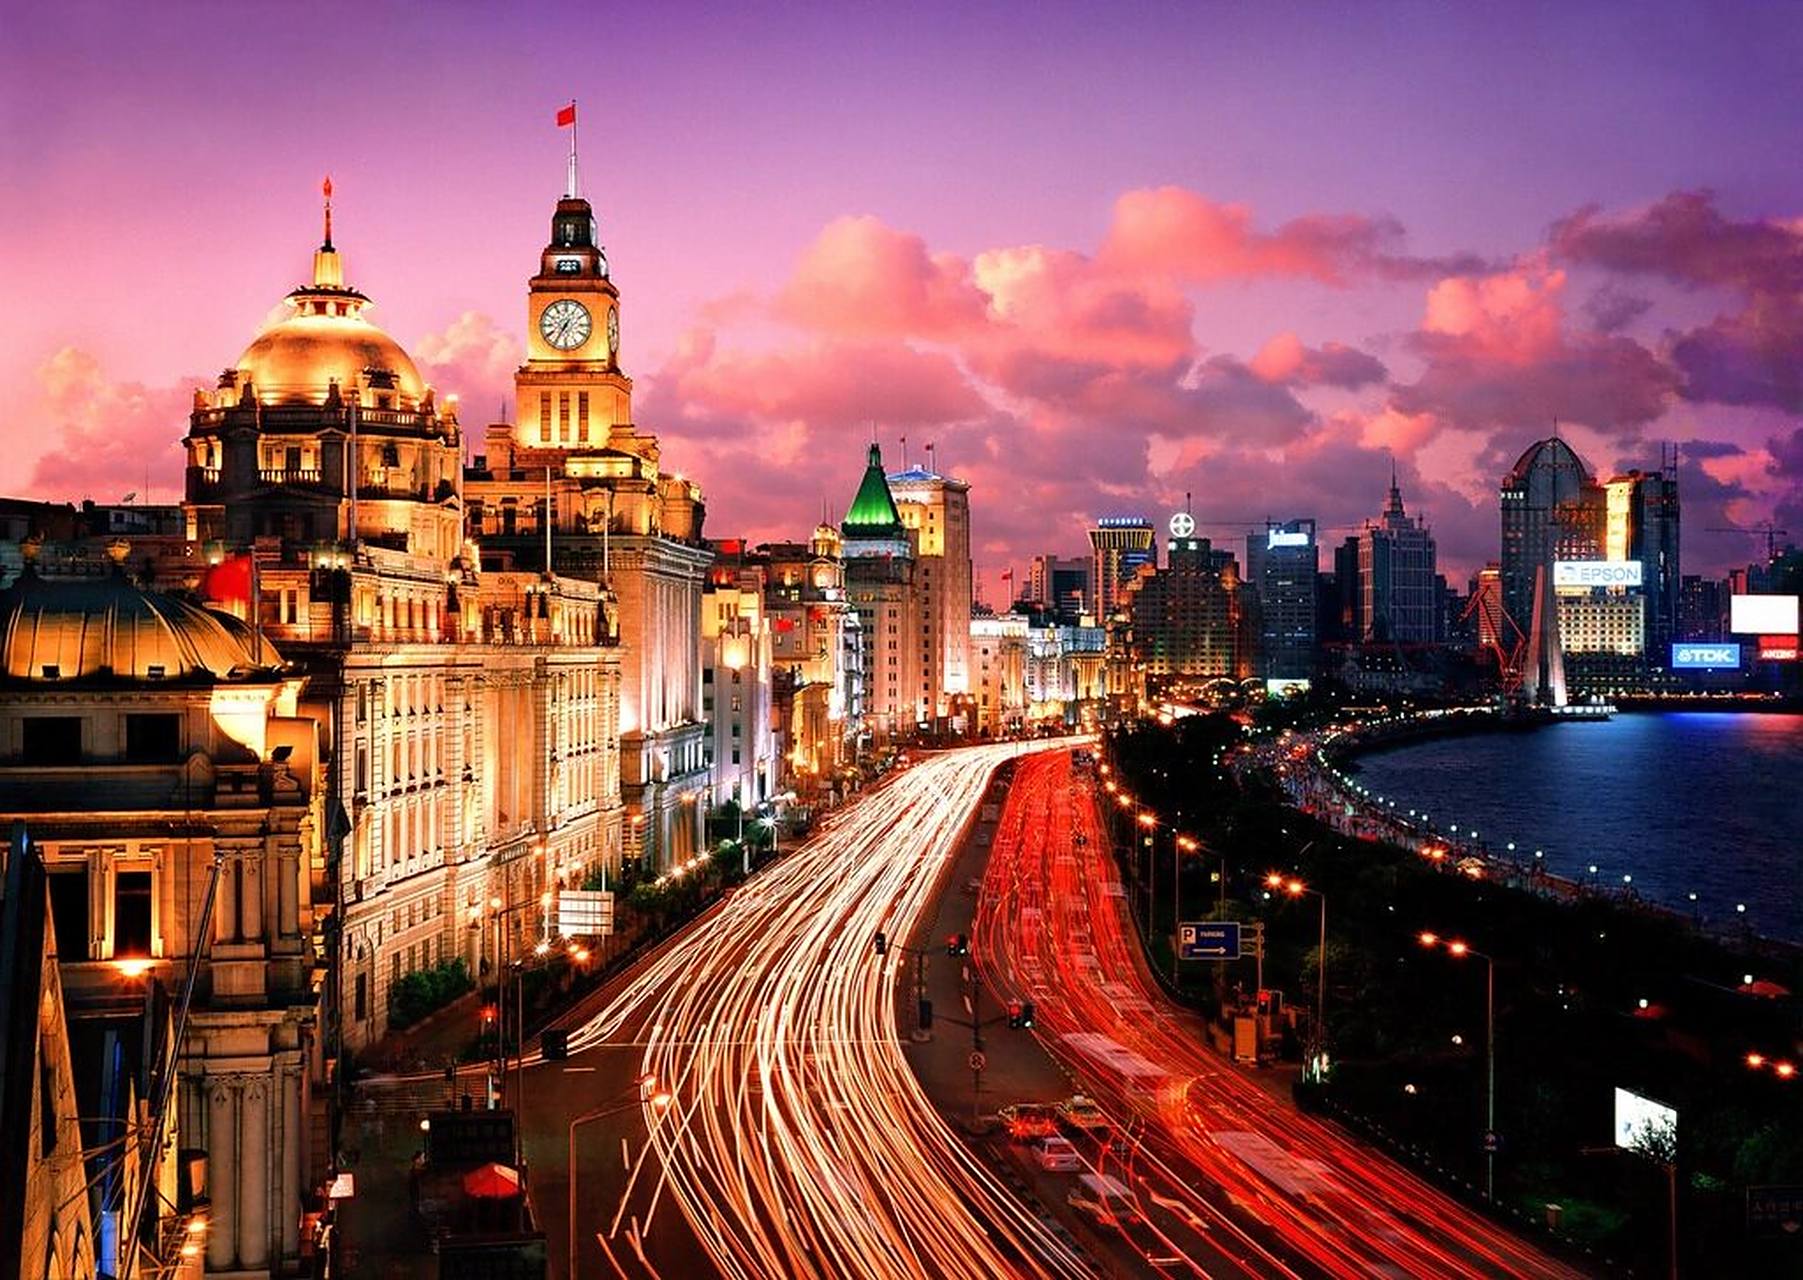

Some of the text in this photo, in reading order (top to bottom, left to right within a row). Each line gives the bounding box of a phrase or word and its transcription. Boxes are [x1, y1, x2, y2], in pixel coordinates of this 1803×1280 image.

[1581, 567, 1638, 582] EPSON
[1690, 649, 1735, 662] TDK
[1183, 928, 1193, 941] P
